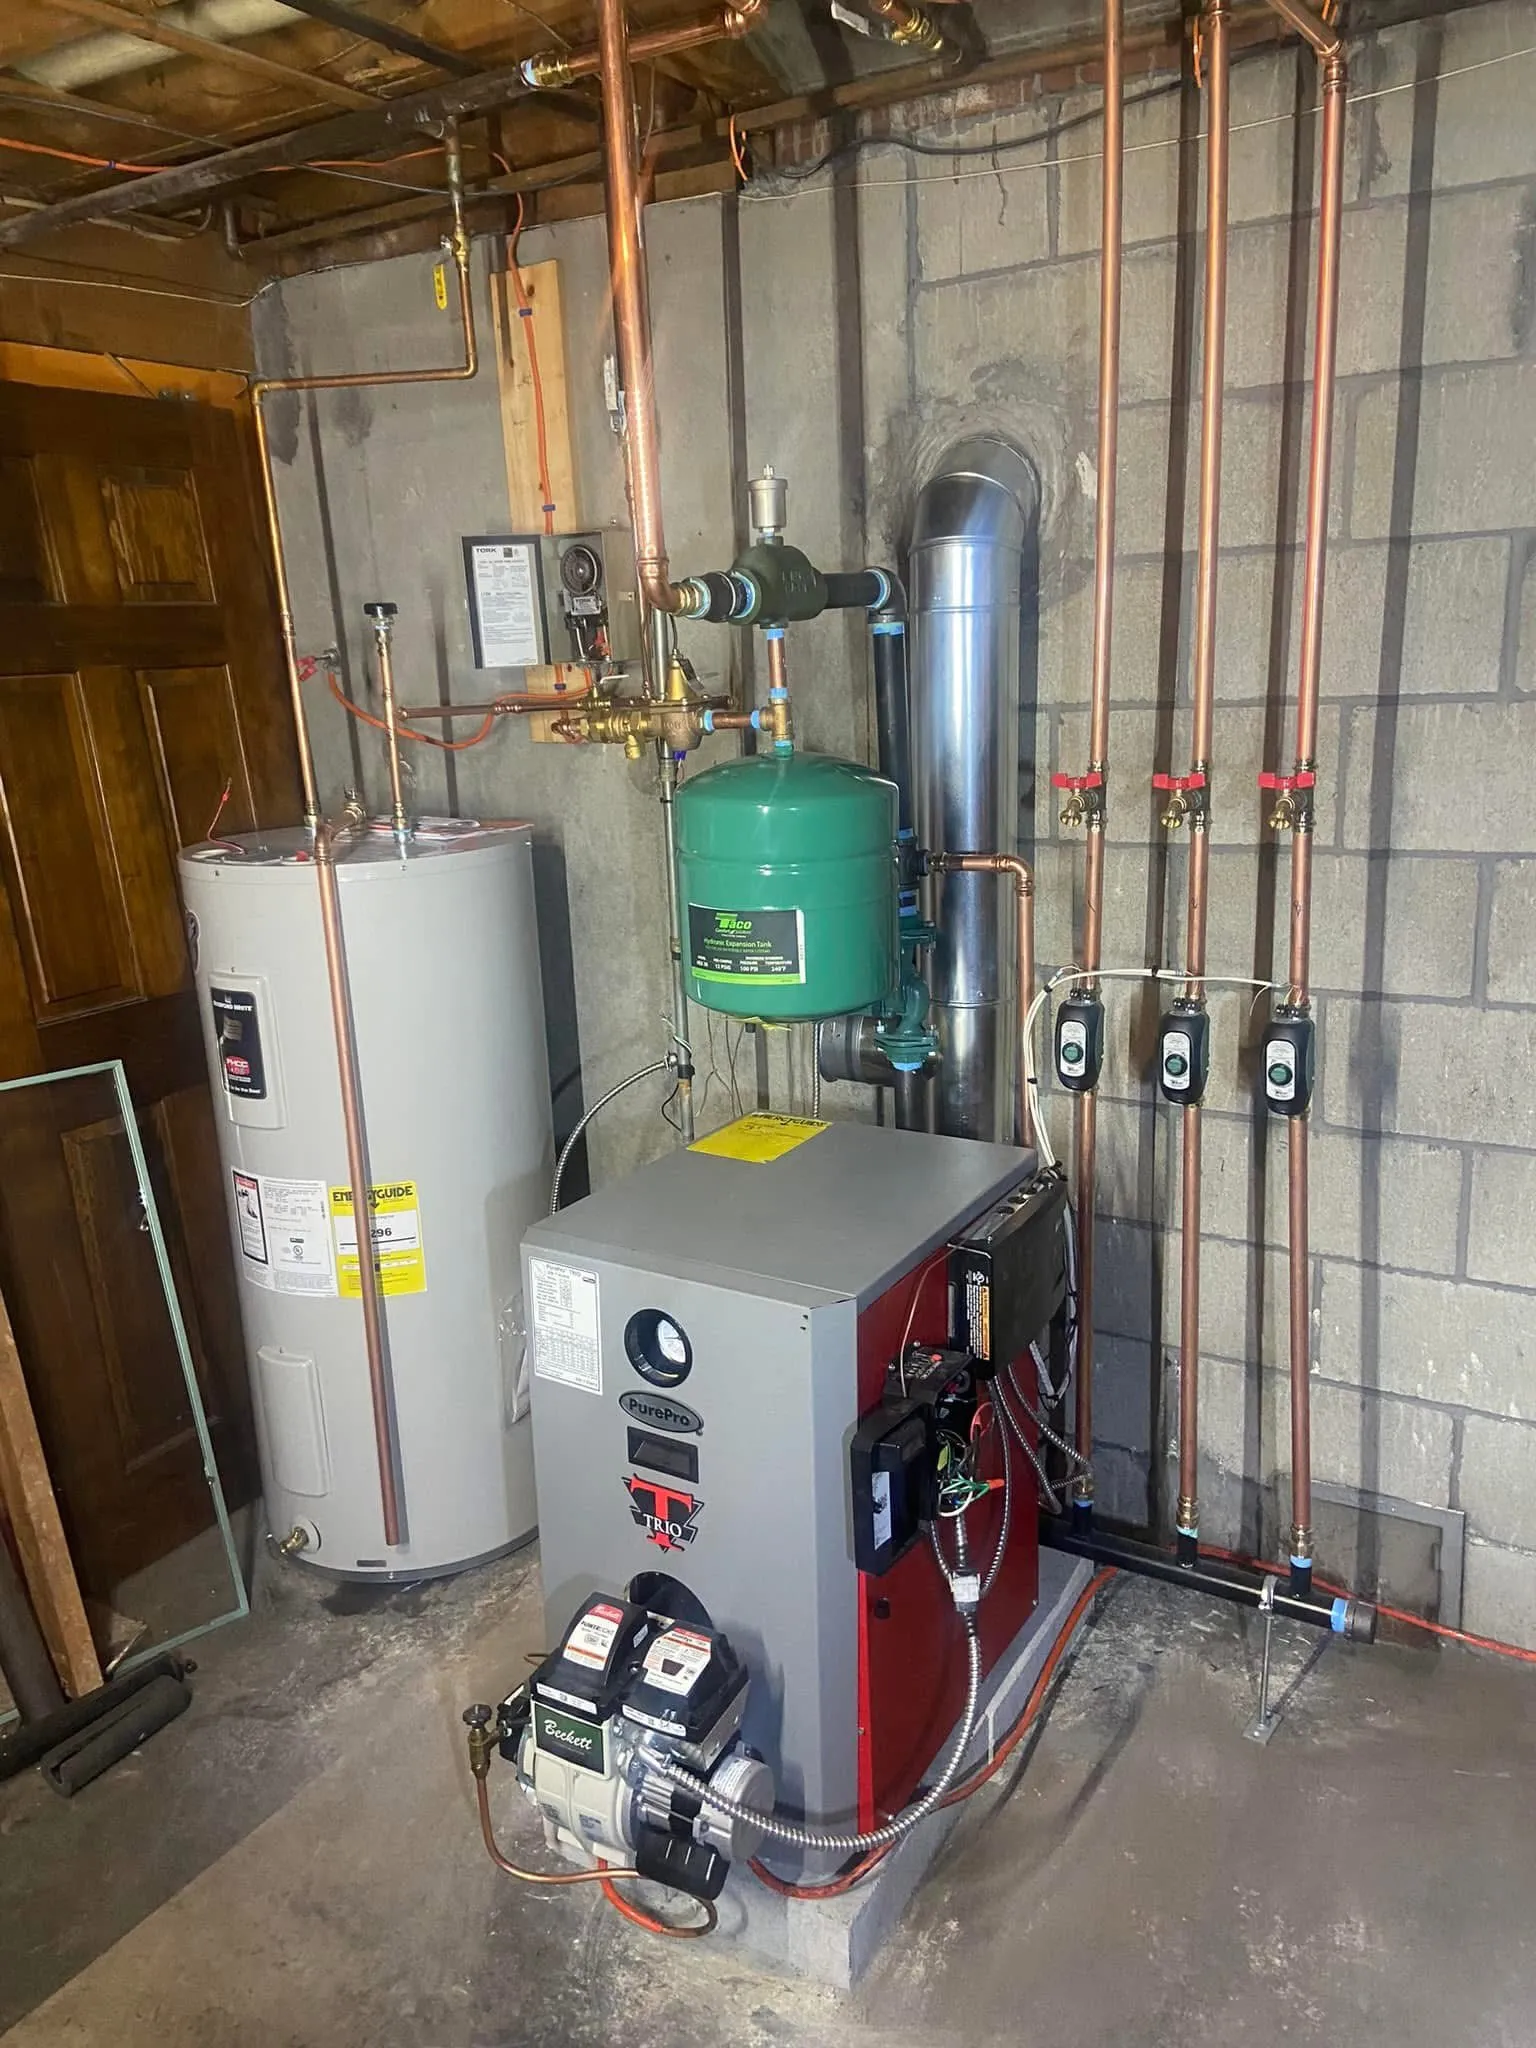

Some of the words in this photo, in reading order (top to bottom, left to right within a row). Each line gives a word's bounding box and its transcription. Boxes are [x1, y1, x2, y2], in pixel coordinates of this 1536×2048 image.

[714, 912, 752, 929] Taco
[725, 940, 756, 949] Expansion
[756, 940, 772, 948] Tank
[332, 1185, 414, 1202] ENEGYGUIDE
[629, 1398, 690, 1426] PurePro
[642, 1513, 682, 1538] TRIO
[543, 1719, 593, 1750] Beckett
